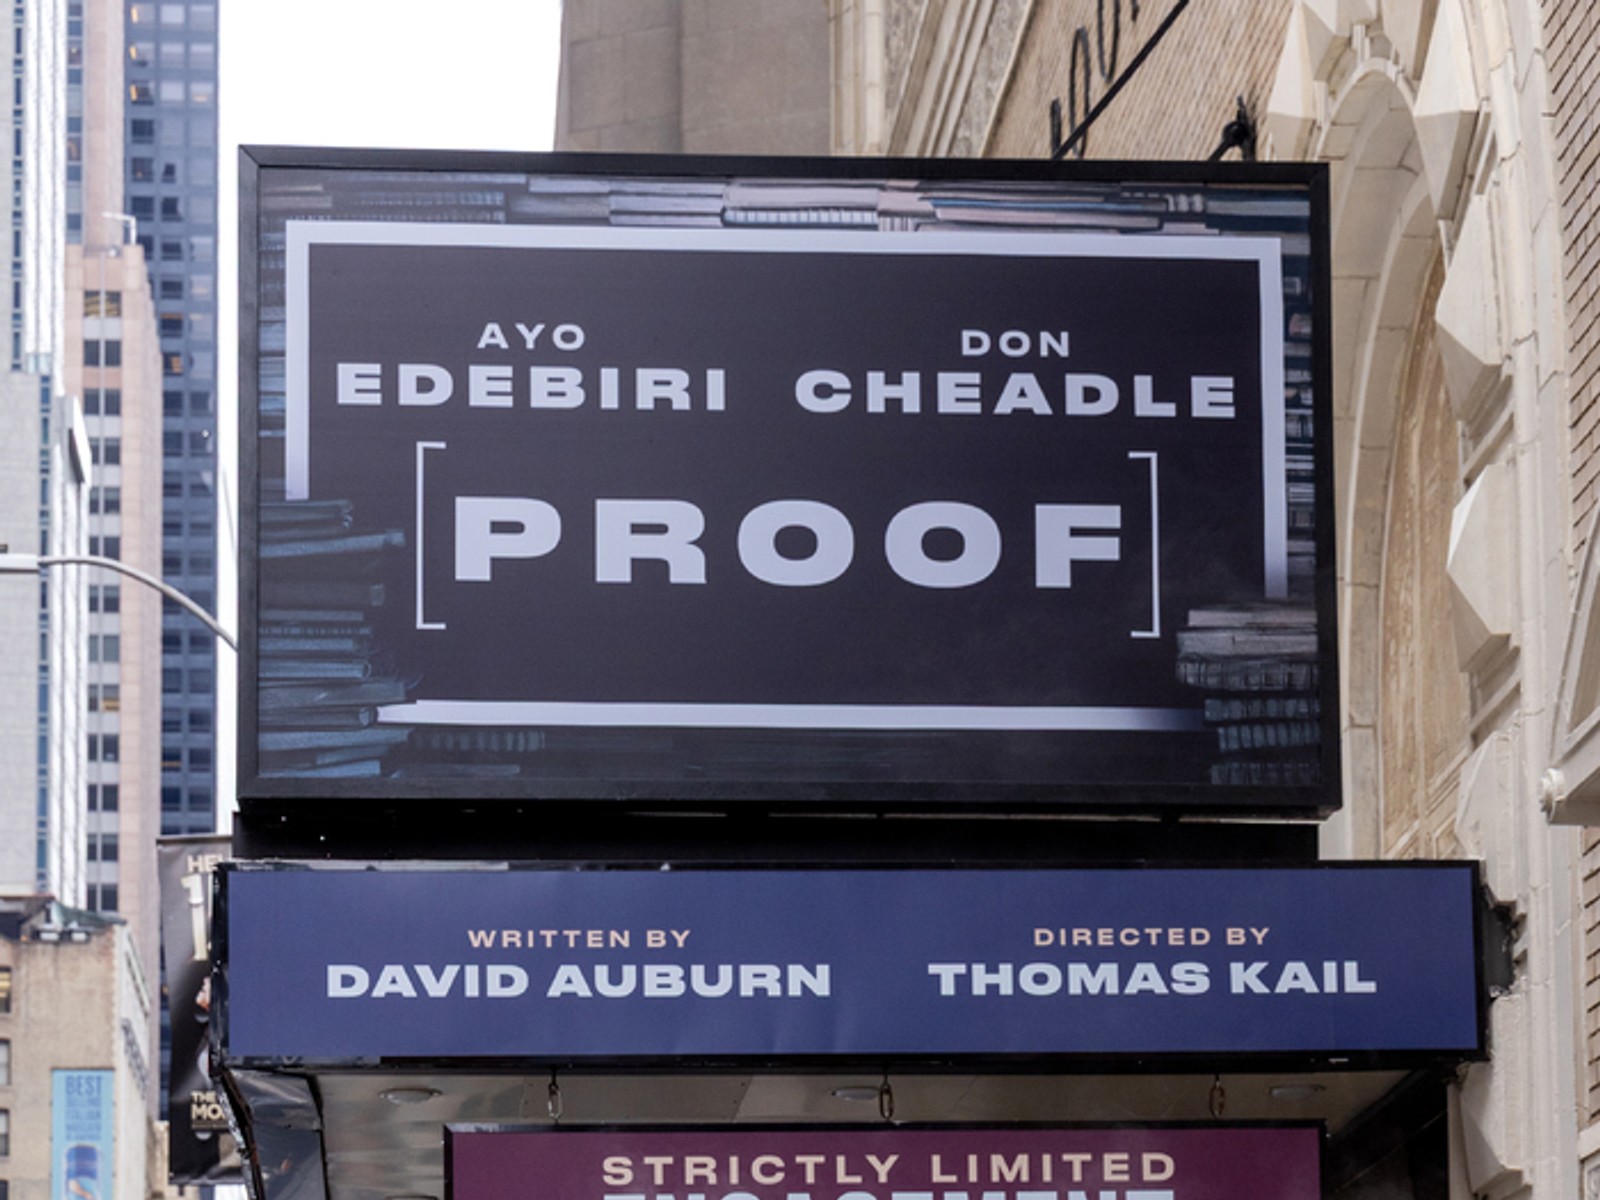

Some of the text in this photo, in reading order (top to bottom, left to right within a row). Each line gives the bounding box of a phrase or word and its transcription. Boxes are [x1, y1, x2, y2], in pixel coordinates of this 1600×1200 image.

[477, 322, 585, 350] AYO
[960, 329, 1070, 358] DON
[337, 362, 725, 411] EDEBIRI
[795, 370, 1236, 419] CHEADLE
[454, 496, 1122, 589] PROOF
[467, 929, 692, 949] WRITTEN BY
[1033, 927, 1271, 947] DIRECTED BY
[326, 964, 831, 999] DAVID AUBURN
[927, 959, 1378, 997] THOMAS KAIL
[65, 1075, 102, 1096] BEST
[191, 1091, 216, 1102] THE
[191, 1103, 225, 1119] MO
[602, 1151, 1176, 1186] STRICTLY LIMITED
